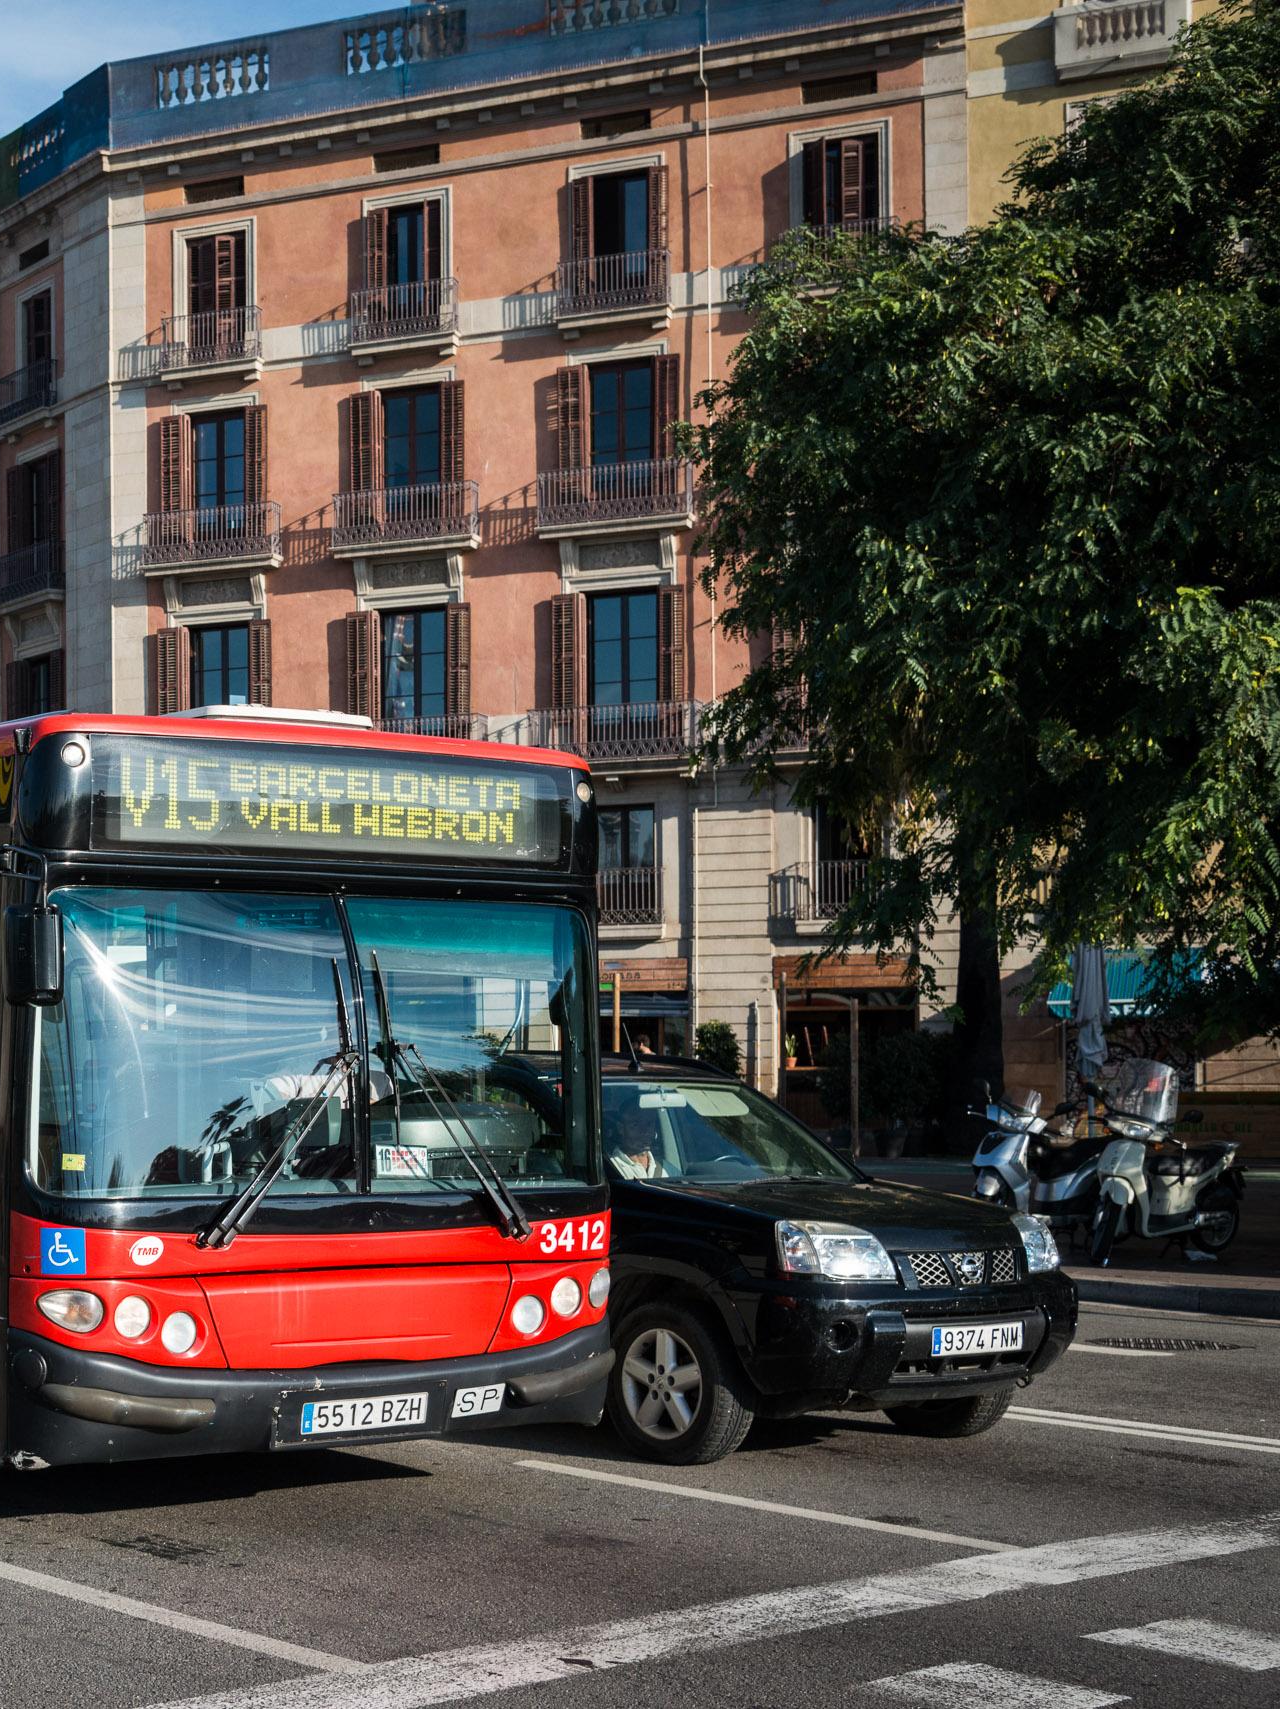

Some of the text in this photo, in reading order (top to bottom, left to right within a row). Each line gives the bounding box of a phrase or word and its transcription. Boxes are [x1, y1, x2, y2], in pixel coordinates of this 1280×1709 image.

[122, 755, 520, 831] V15 BARCELONETA
[241, 797, 514, 843] VALL HEBRON
[379, 1148, 391, 1172] 16
[136, 1246, 159, 1256] TMB
[540, 1220, 605, 1254] 3412
[944, 1329, 985, 1351] 9374
[990, 1326, 1019, 1348] FNM
[317, 1402, 374, 1428] 5512
[381, 1397, 422, 1423] BZH
[459, 1388, 498, 1413] SP
